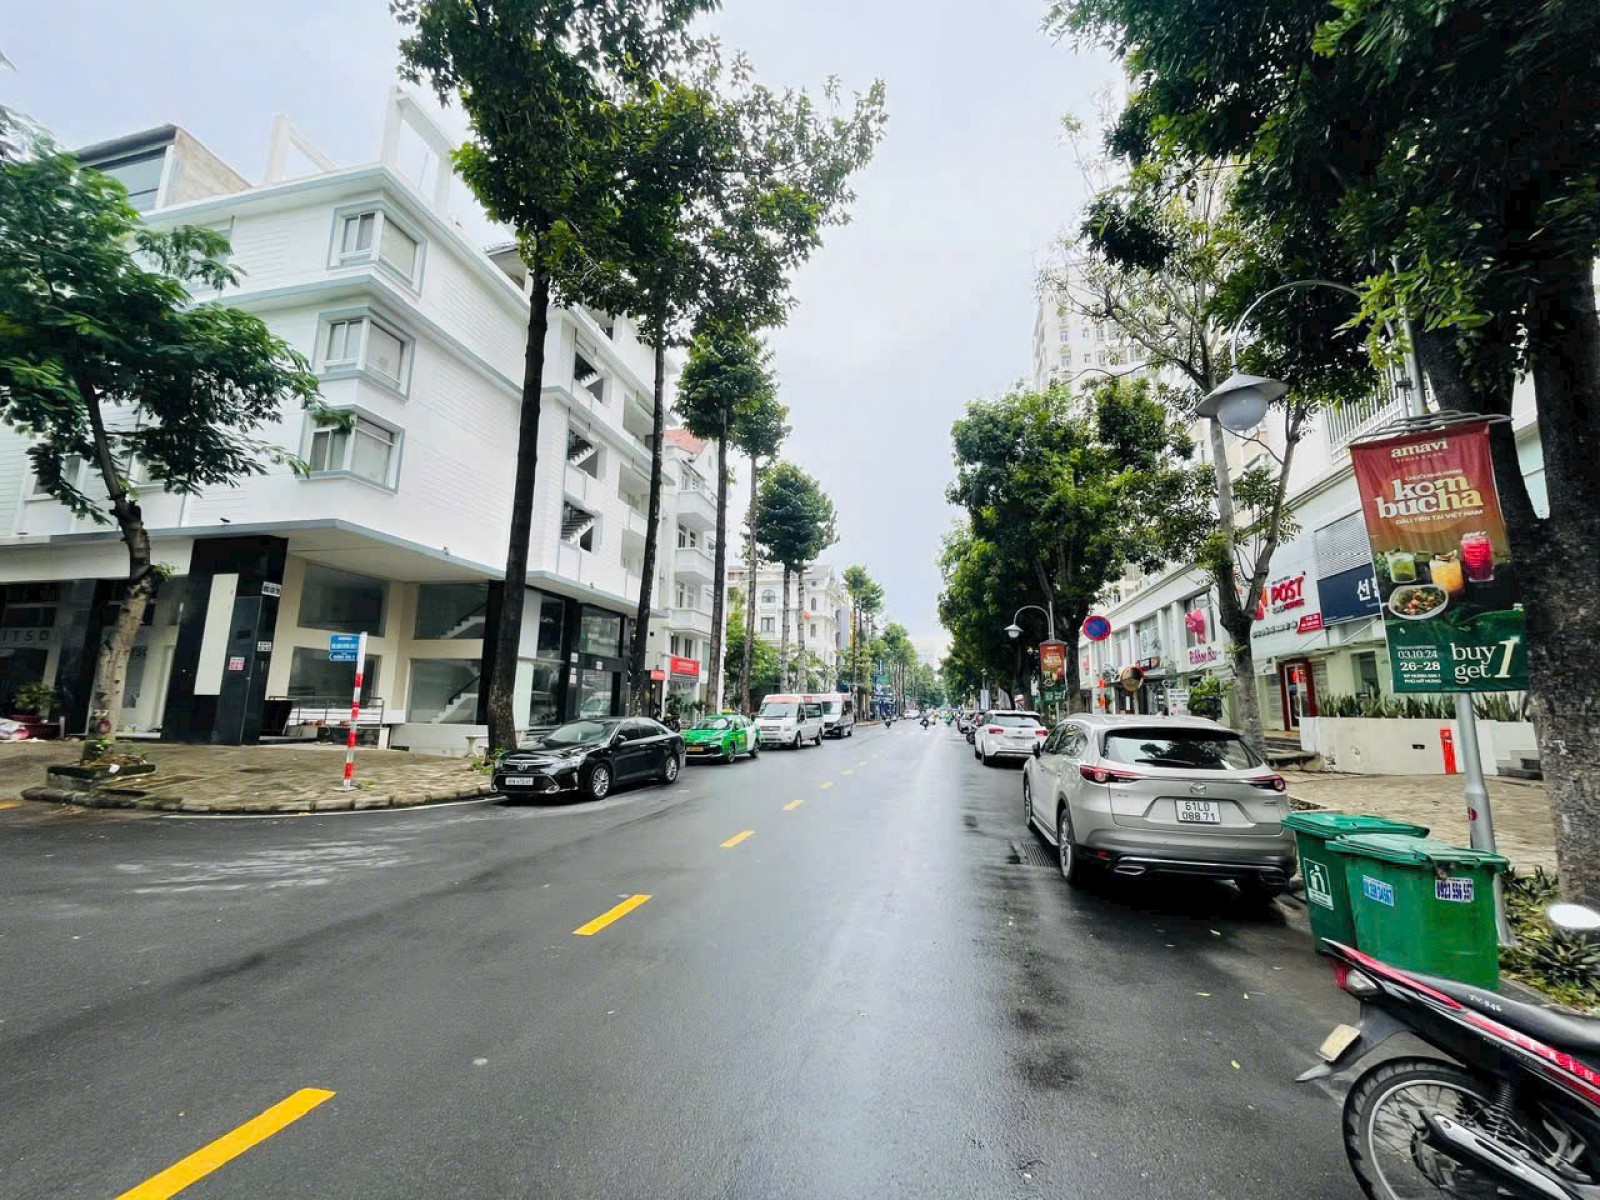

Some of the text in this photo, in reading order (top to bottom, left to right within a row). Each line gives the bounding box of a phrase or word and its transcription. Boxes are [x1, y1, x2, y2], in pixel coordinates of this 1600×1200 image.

[1391, 440, 1448, 458] amavi
[1391, 475, 1470, 500] kom
[1374, 486, 1484, 520] bucha
[1271, 576, 1304, 606] POST
[1397, 649, 1438, 660] 03.10.24
[1449, 638, 1516, 679] buy 1
[1400, 661, 1441, 672] 26-28
[1454, 663, 1492, 685] get
